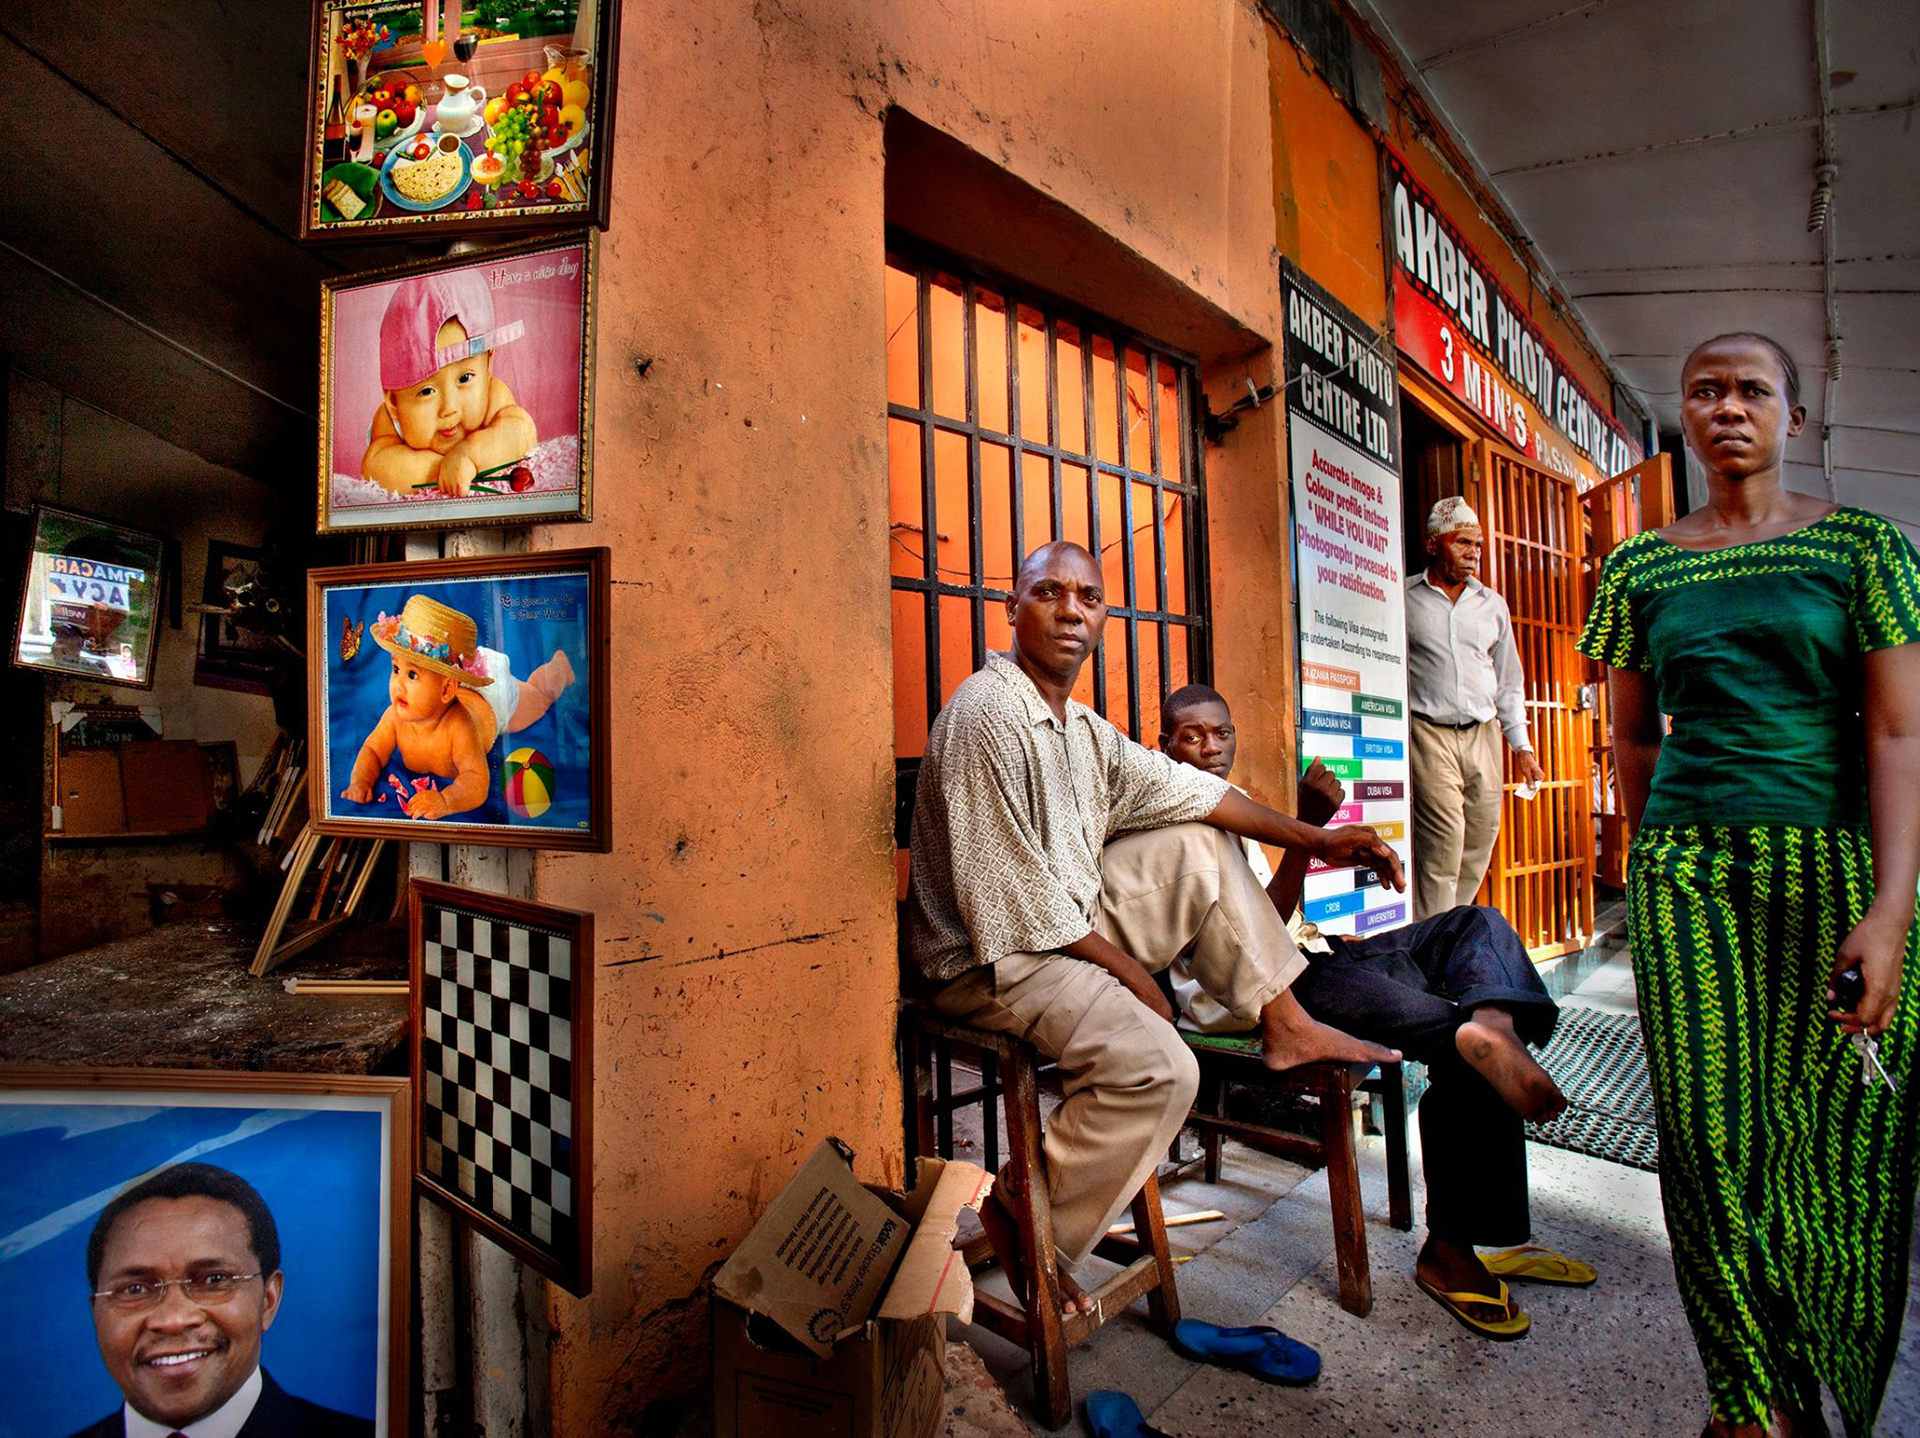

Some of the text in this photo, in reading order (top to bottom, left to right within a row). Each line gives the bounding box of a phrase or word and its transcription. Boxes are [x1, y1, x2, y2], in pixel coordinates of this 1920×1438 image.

[1393, 181, 1490, 347] AKBER
[1497, 293, 1553, 418] PHOTO
[1556, 375, 1608, 473] CENTRE
[1289, 289, 1393, 407] AKBER PHOTO
[1439, 326, 1454, 383] 3
[1301, 362, 1362, 444] CENTRE
[1312, 449, 1383, 505] Accurate image &
[1305, 472, 1389, 532] Colour profile instant
[1346, 518, 1364, 544] YOU
[1298, 523, 1398, 583] Photographs processed to
[1317, 565, 1337, 584] your
[1314, 609, 1324, 624] The
[1325, 613, 1348, 634] following
[1348, 620, 1359, 634] Visa
[1310, 633, 1340, 649] undertaken
[1341, 639, 1366, 659] According
[1330, 672, 1357, 687] PASSPORT
[1361, 701, 1396, 714] AMERICAN VISA
[1310, 716, 1352, 730] CANADIAN VISA
[1365, 744, 1394, 754] BRITISH VISA
[1336, 764, 1348, 775] VISA
[1367, 786, 1393, 796] DUBAI VISA
[1338, 810, 1350, 820] VISA
[875, 1218, 898, 1247] Kodak
